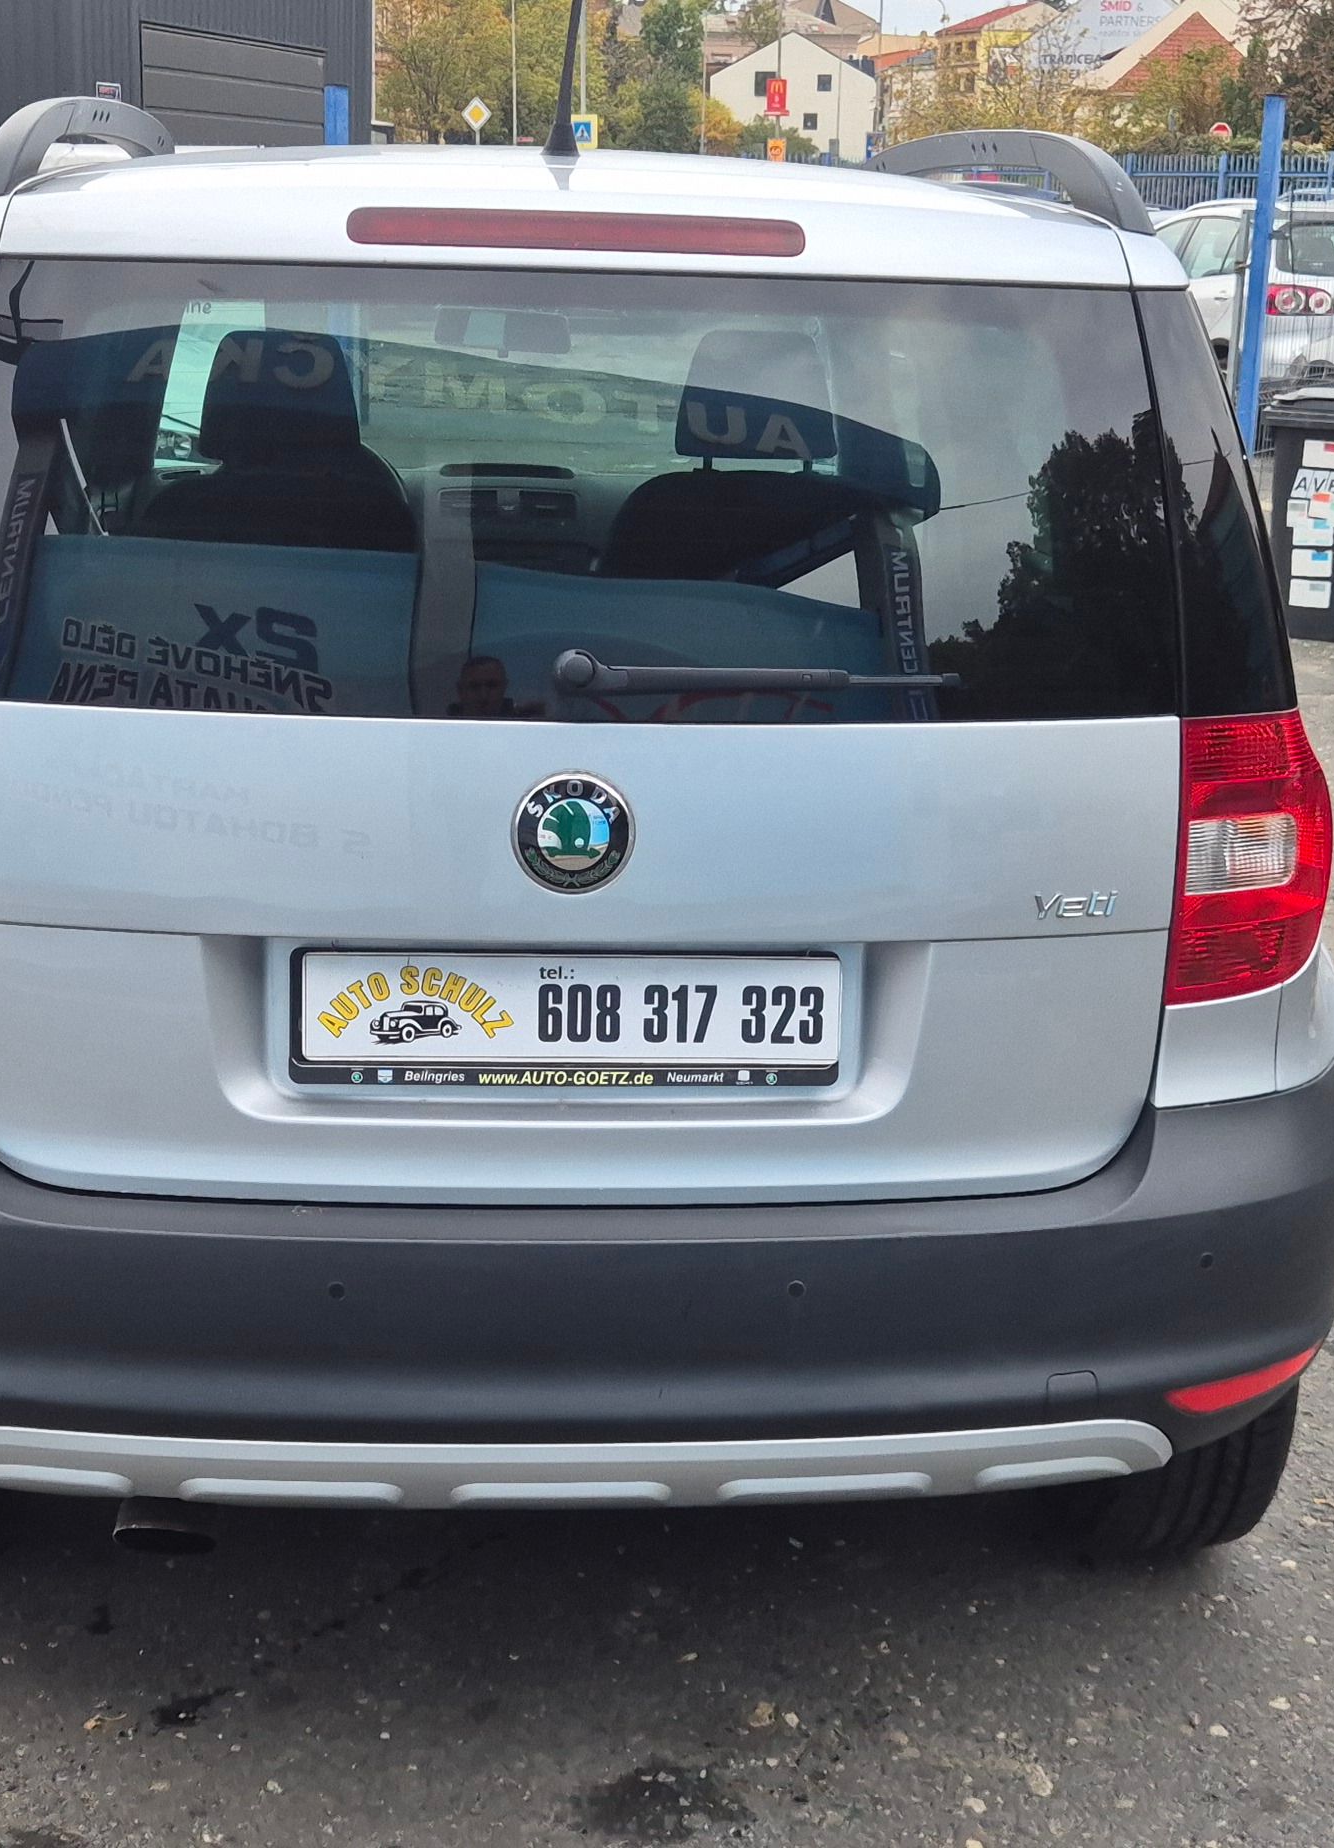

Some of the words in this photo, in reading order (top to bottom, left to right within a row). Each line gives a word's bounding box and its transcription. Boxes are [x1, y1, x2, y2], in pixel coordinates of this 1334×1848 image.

[1034, 890, 1118, 920] Yeti
[539, 966, 575, 980] tel.:
[317, 972, 391, 1038] AUTO
[399, 966, 515, 1039] SCHULZ
[538, 983, 622, 1042] 608
[643, 984, 718, 1043] 317
[741, 985, 824, 1044] 323
[478, 1071, 654, 1085] www.AUTO-GOETZ.de
[667, 1072, 724, 1084] Neumarkt
